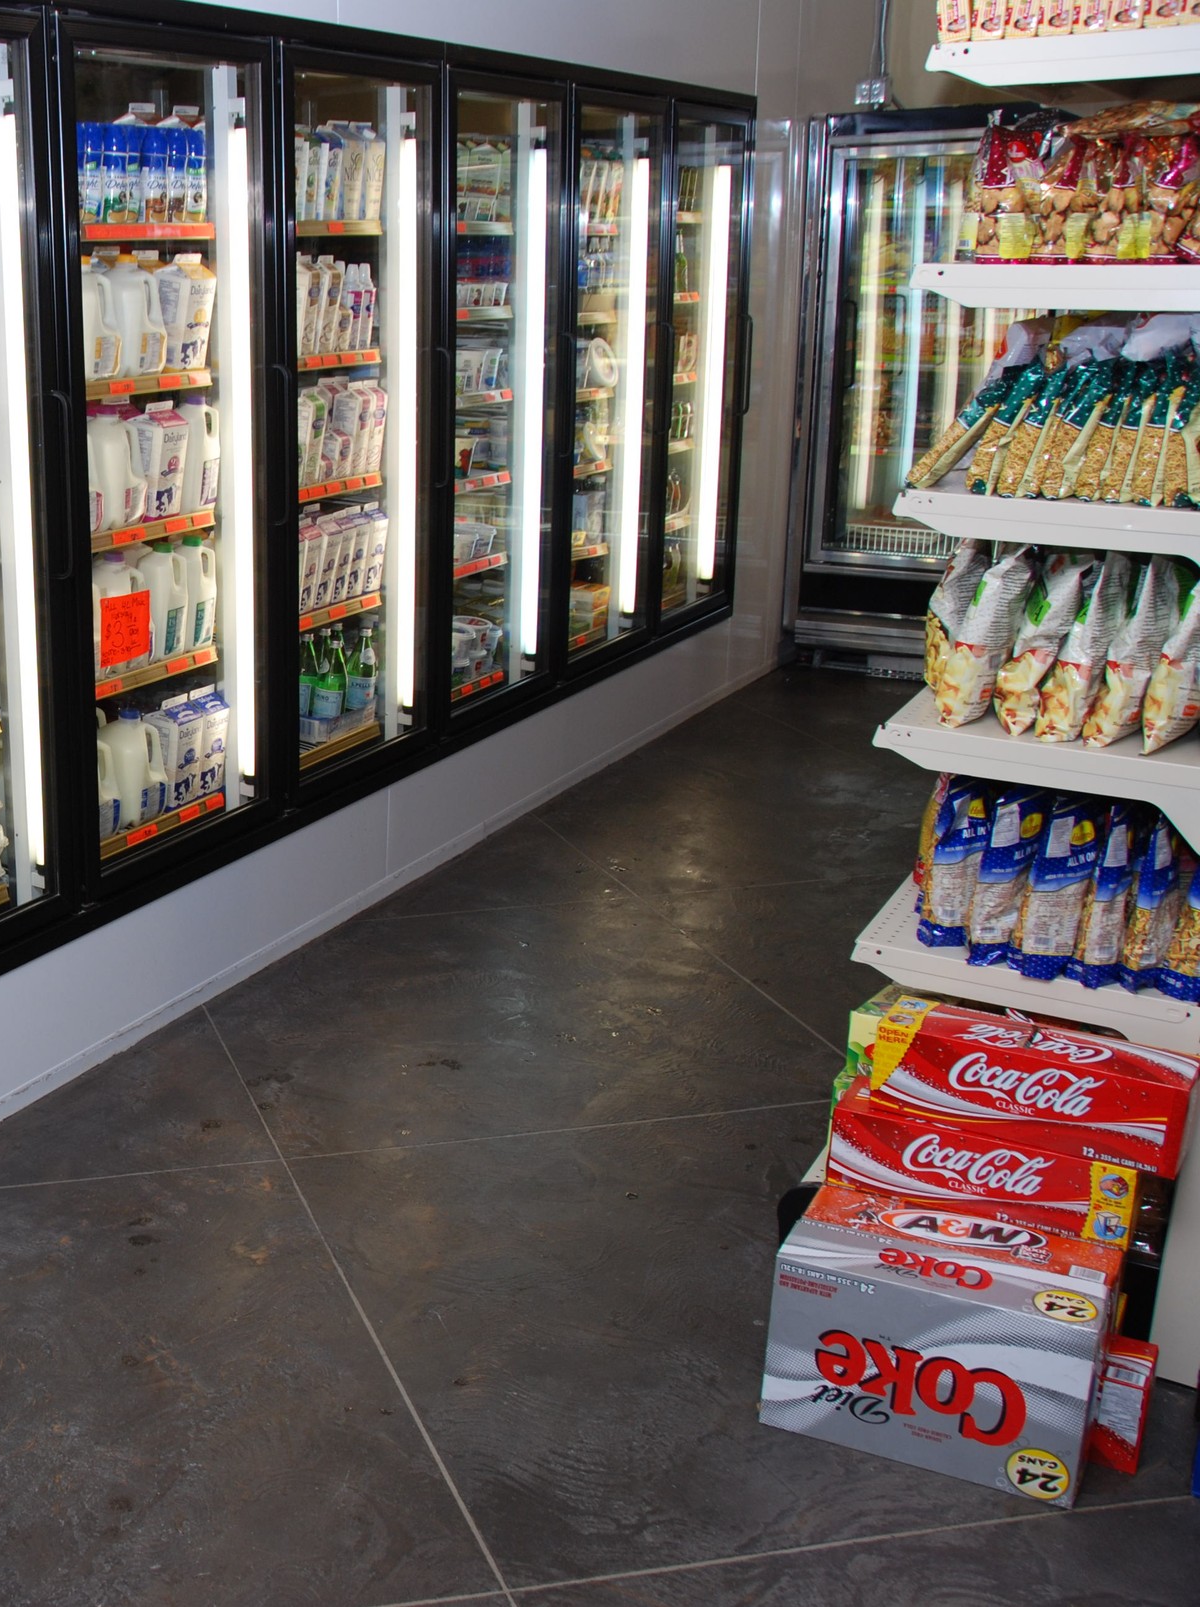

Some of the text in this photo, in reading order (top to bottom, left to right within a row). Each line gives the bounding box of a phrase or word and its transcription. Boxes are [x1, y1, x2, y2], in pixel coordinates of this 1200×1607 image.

[962, 829, 975, 839] ALL
[1067, 851, 1097, 867] ALL IN ON
[879, 1034, 908, 1044] HERE
[953, 1024, 1114, 1064] CocaCola
[948, 1052, 1105, 1117] Coca-Cola
[995, 1100, 1036, 1116] CLASSIC
[902, 1133, 1057, 1197] Coca-Cola
[1082, 1146, 1095, 1158] 12
[1120, 1157, 1136, 1168] CANS
[948, 1180, 987, 1195] CLASSIC
[899, 1214, 1023, 1247] A&W
[807, 1269, 825, 1280] CANS
[874, 1263, 919, 1280] Diet
[878, 1247, 994, 1291] Coke
[837, 1277, 852, 1286] 355
[860, 1282, 876, 1295] 24
[1044, 1292, 1088, 1305] CANS
[1045, 1302, 1095, 1319] 24
[814, 1328, 1028, 1448] Coke
[812, 1383, 891, 1425] Diet
[1017, 1454, 1059, 1470] CANS
[1016, 1465, 1061, 1493] 24
